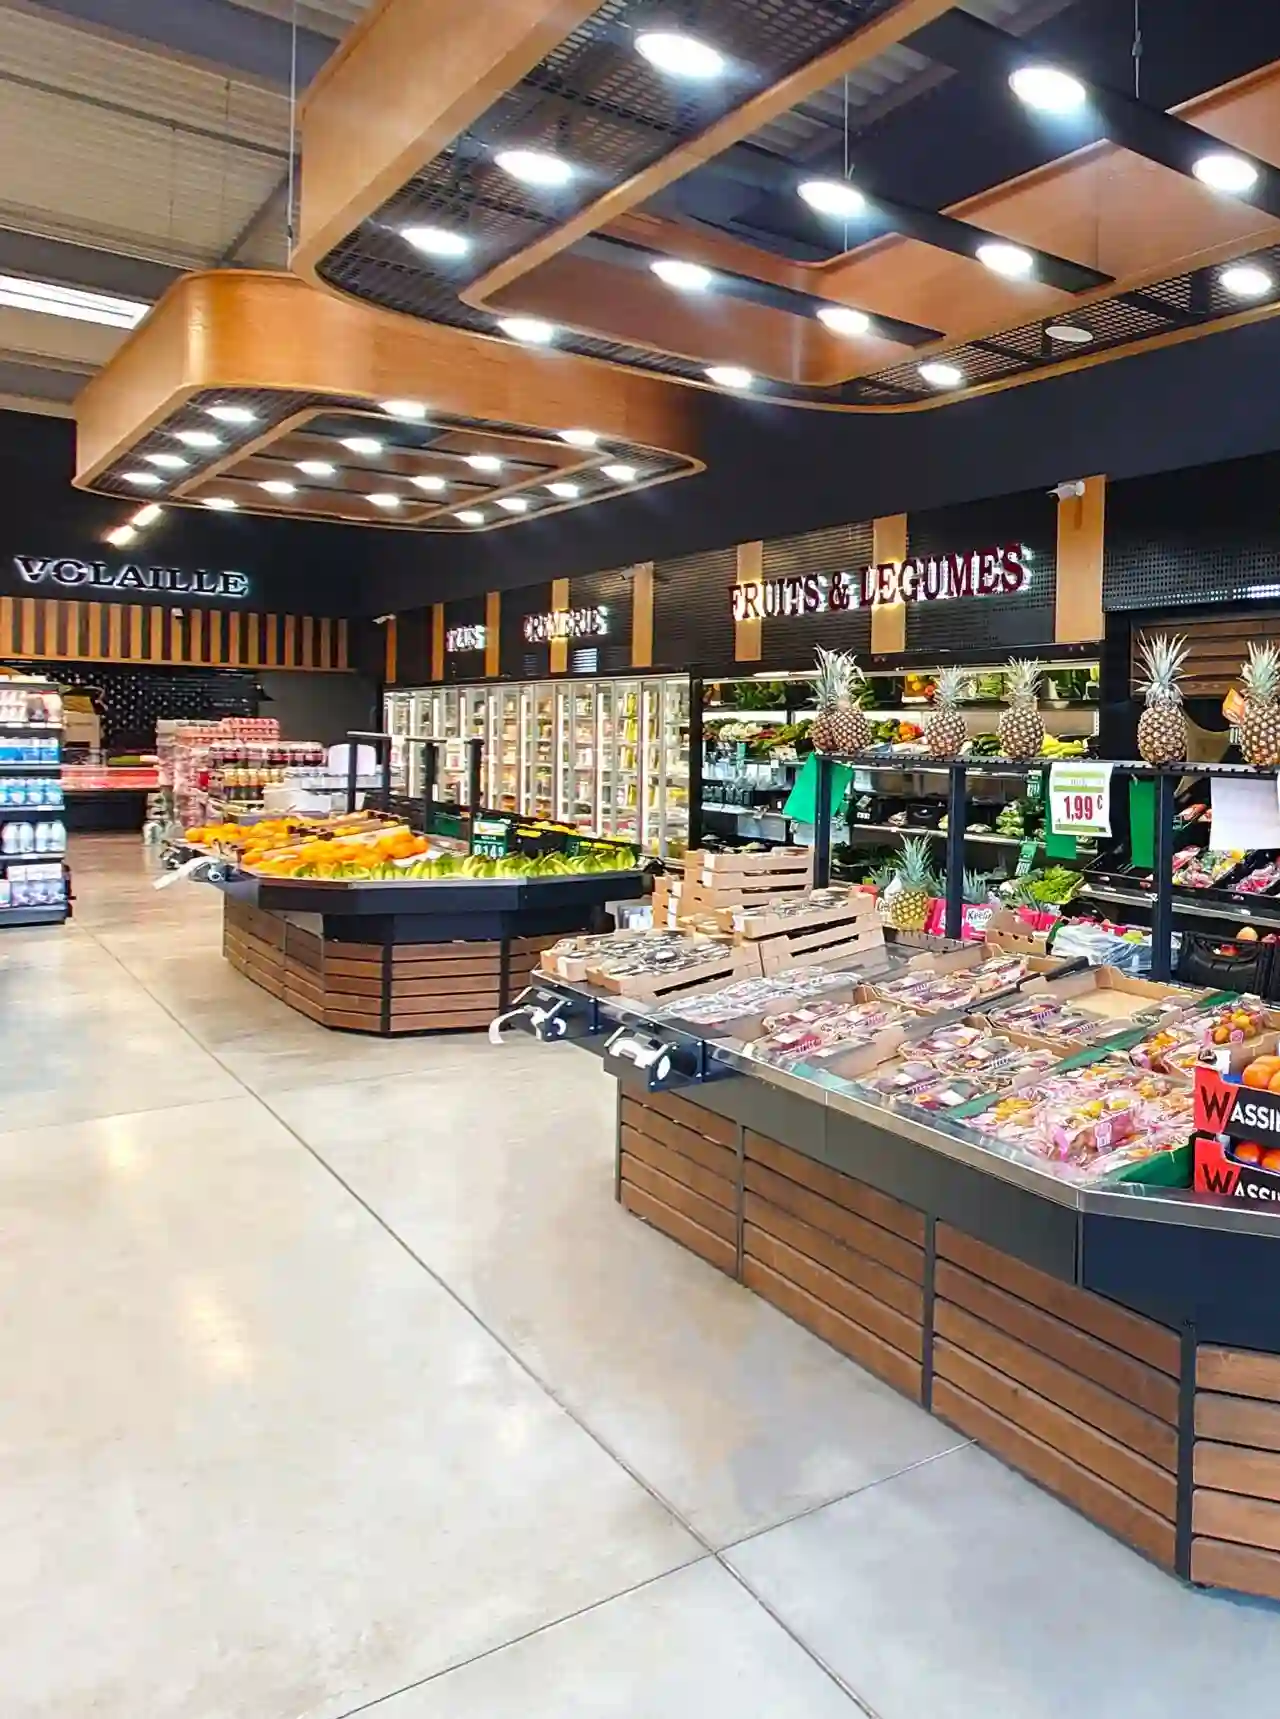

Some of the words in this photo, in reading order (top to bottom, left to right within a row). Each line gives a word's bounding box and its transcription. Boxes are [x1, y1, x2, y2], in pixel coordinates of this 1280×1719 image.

[14, 555, 250, 598] VOLAILLE
[728, 571, 827, 621] FRUITS
[831, 571, 855, 611] &
[860, 543, 1030, 607] LEGUMES
[1063, 794, 1093, 821] 1,99
